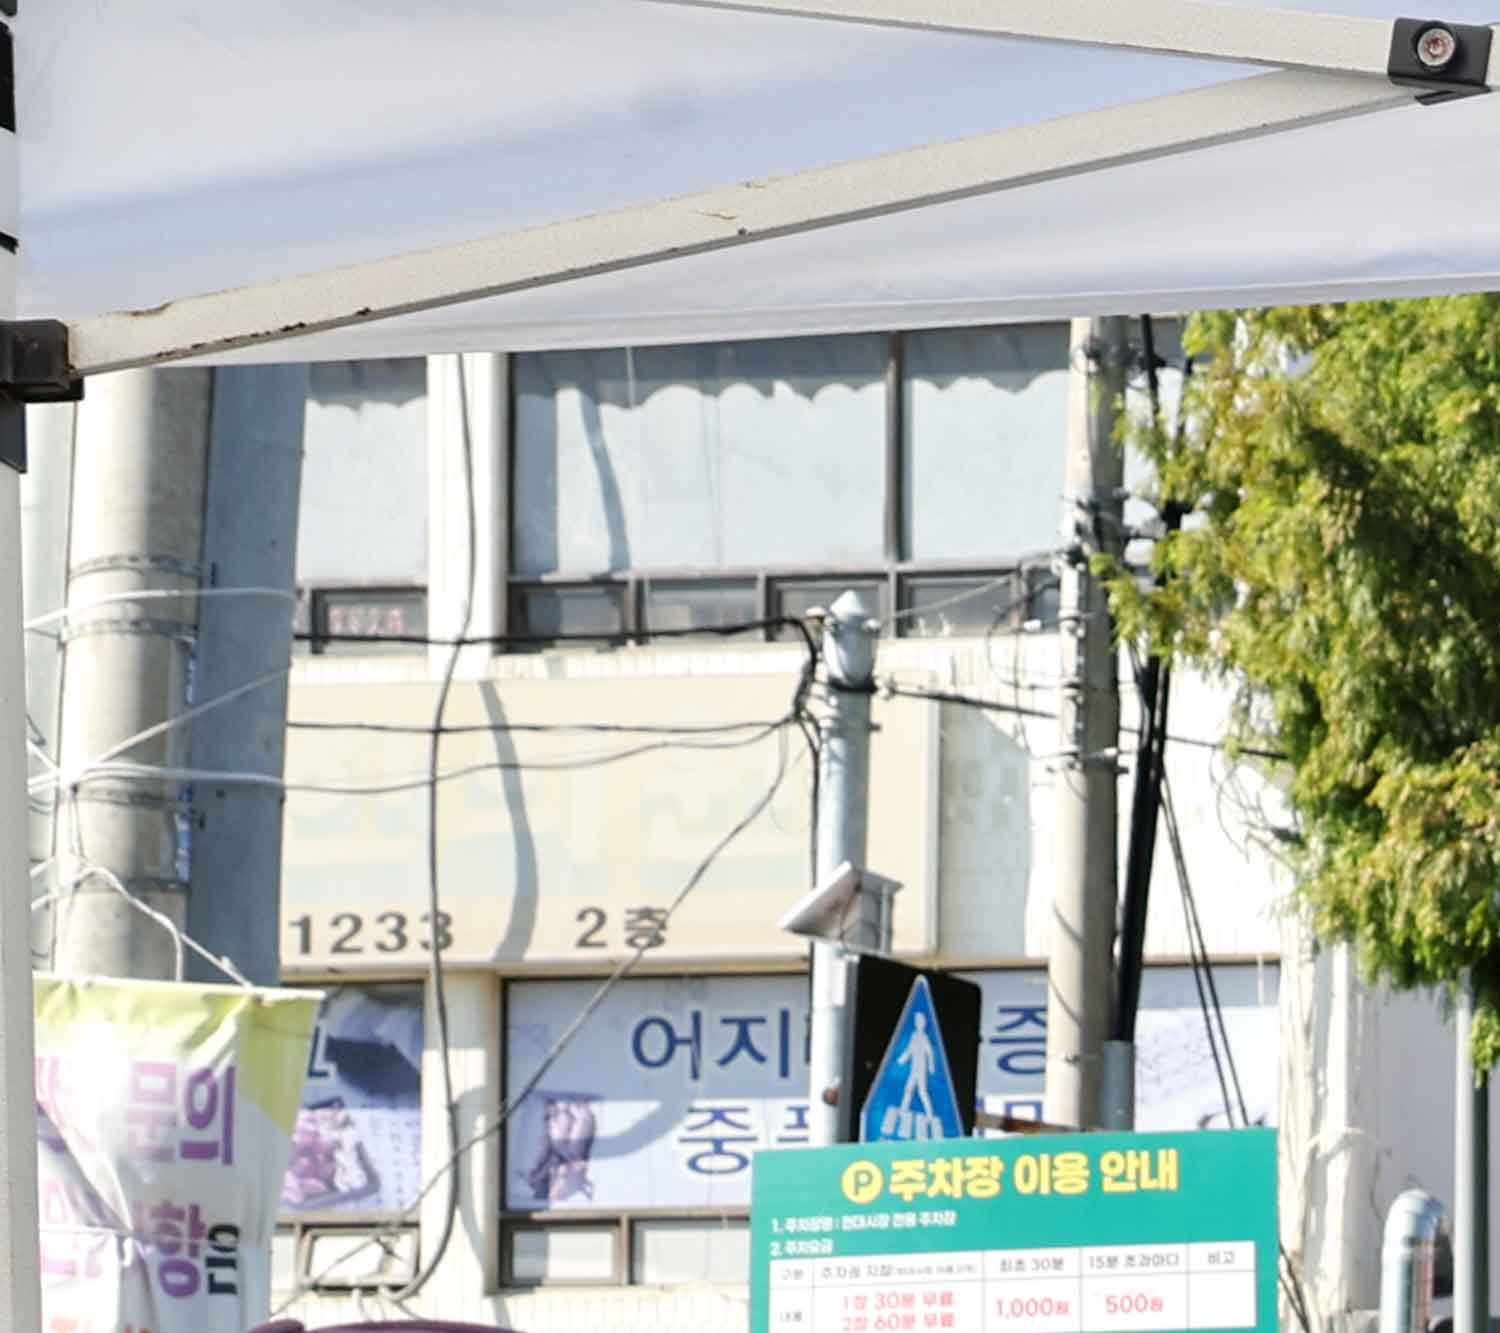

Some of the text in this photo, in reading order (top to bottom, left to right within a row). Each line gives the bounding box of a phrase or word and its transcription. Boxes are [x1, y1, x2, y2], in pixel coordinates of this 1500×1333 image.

[289, 909, 454, 955] 1233
[575, 906, 670, 950] 2층
[888, 1155, 1005, 1203] 주차장
[1013, 1151, 1091, 1197] 이용
[1099, 1148, 1181, 1193] 안내
[1031, 1257, 1065, 1273] 30분
[1089, 1254, 1119, 1270] 15분
[873, 1291, 917, 1310] 30분
[995, 1296, 1071, 1321] 1,000원
[1104, 1292, 1164, 1315] 500원
[873, 1313, 917, 1332] 60분
